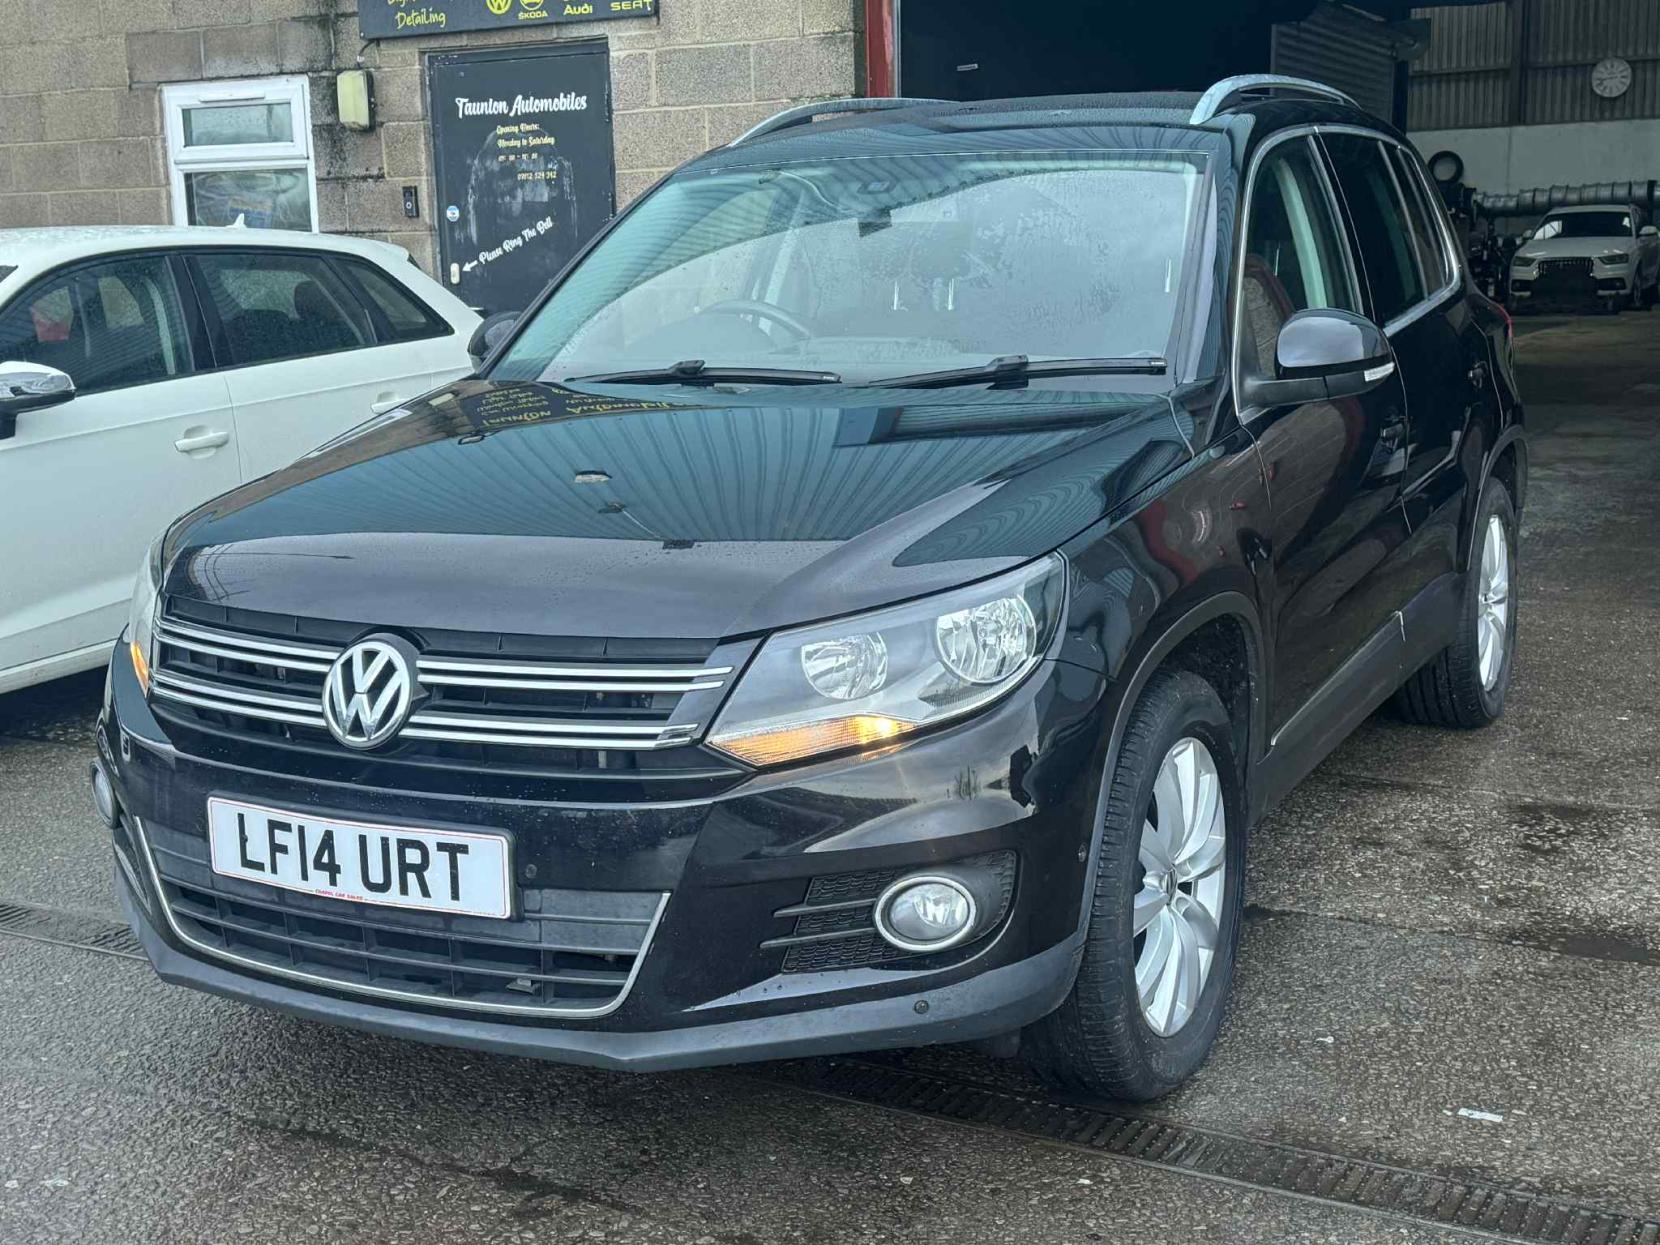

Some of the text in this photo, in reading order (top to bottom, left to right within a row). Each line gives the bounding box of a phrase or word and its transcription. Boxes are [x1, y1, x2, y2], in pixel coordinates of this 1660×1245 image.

[563, 3, 593, 16] Audi
[610, 0, 653, 11] SEAT
[395, 7, 446, 29] Detailing
[455, 91, 588, 119] Taunton Automobiles
[528, 135, 556, 147] Saturday
[478, 216, 553, 265] Please Ring The Bell
[237, 812, 470, 902] LF14 URT
